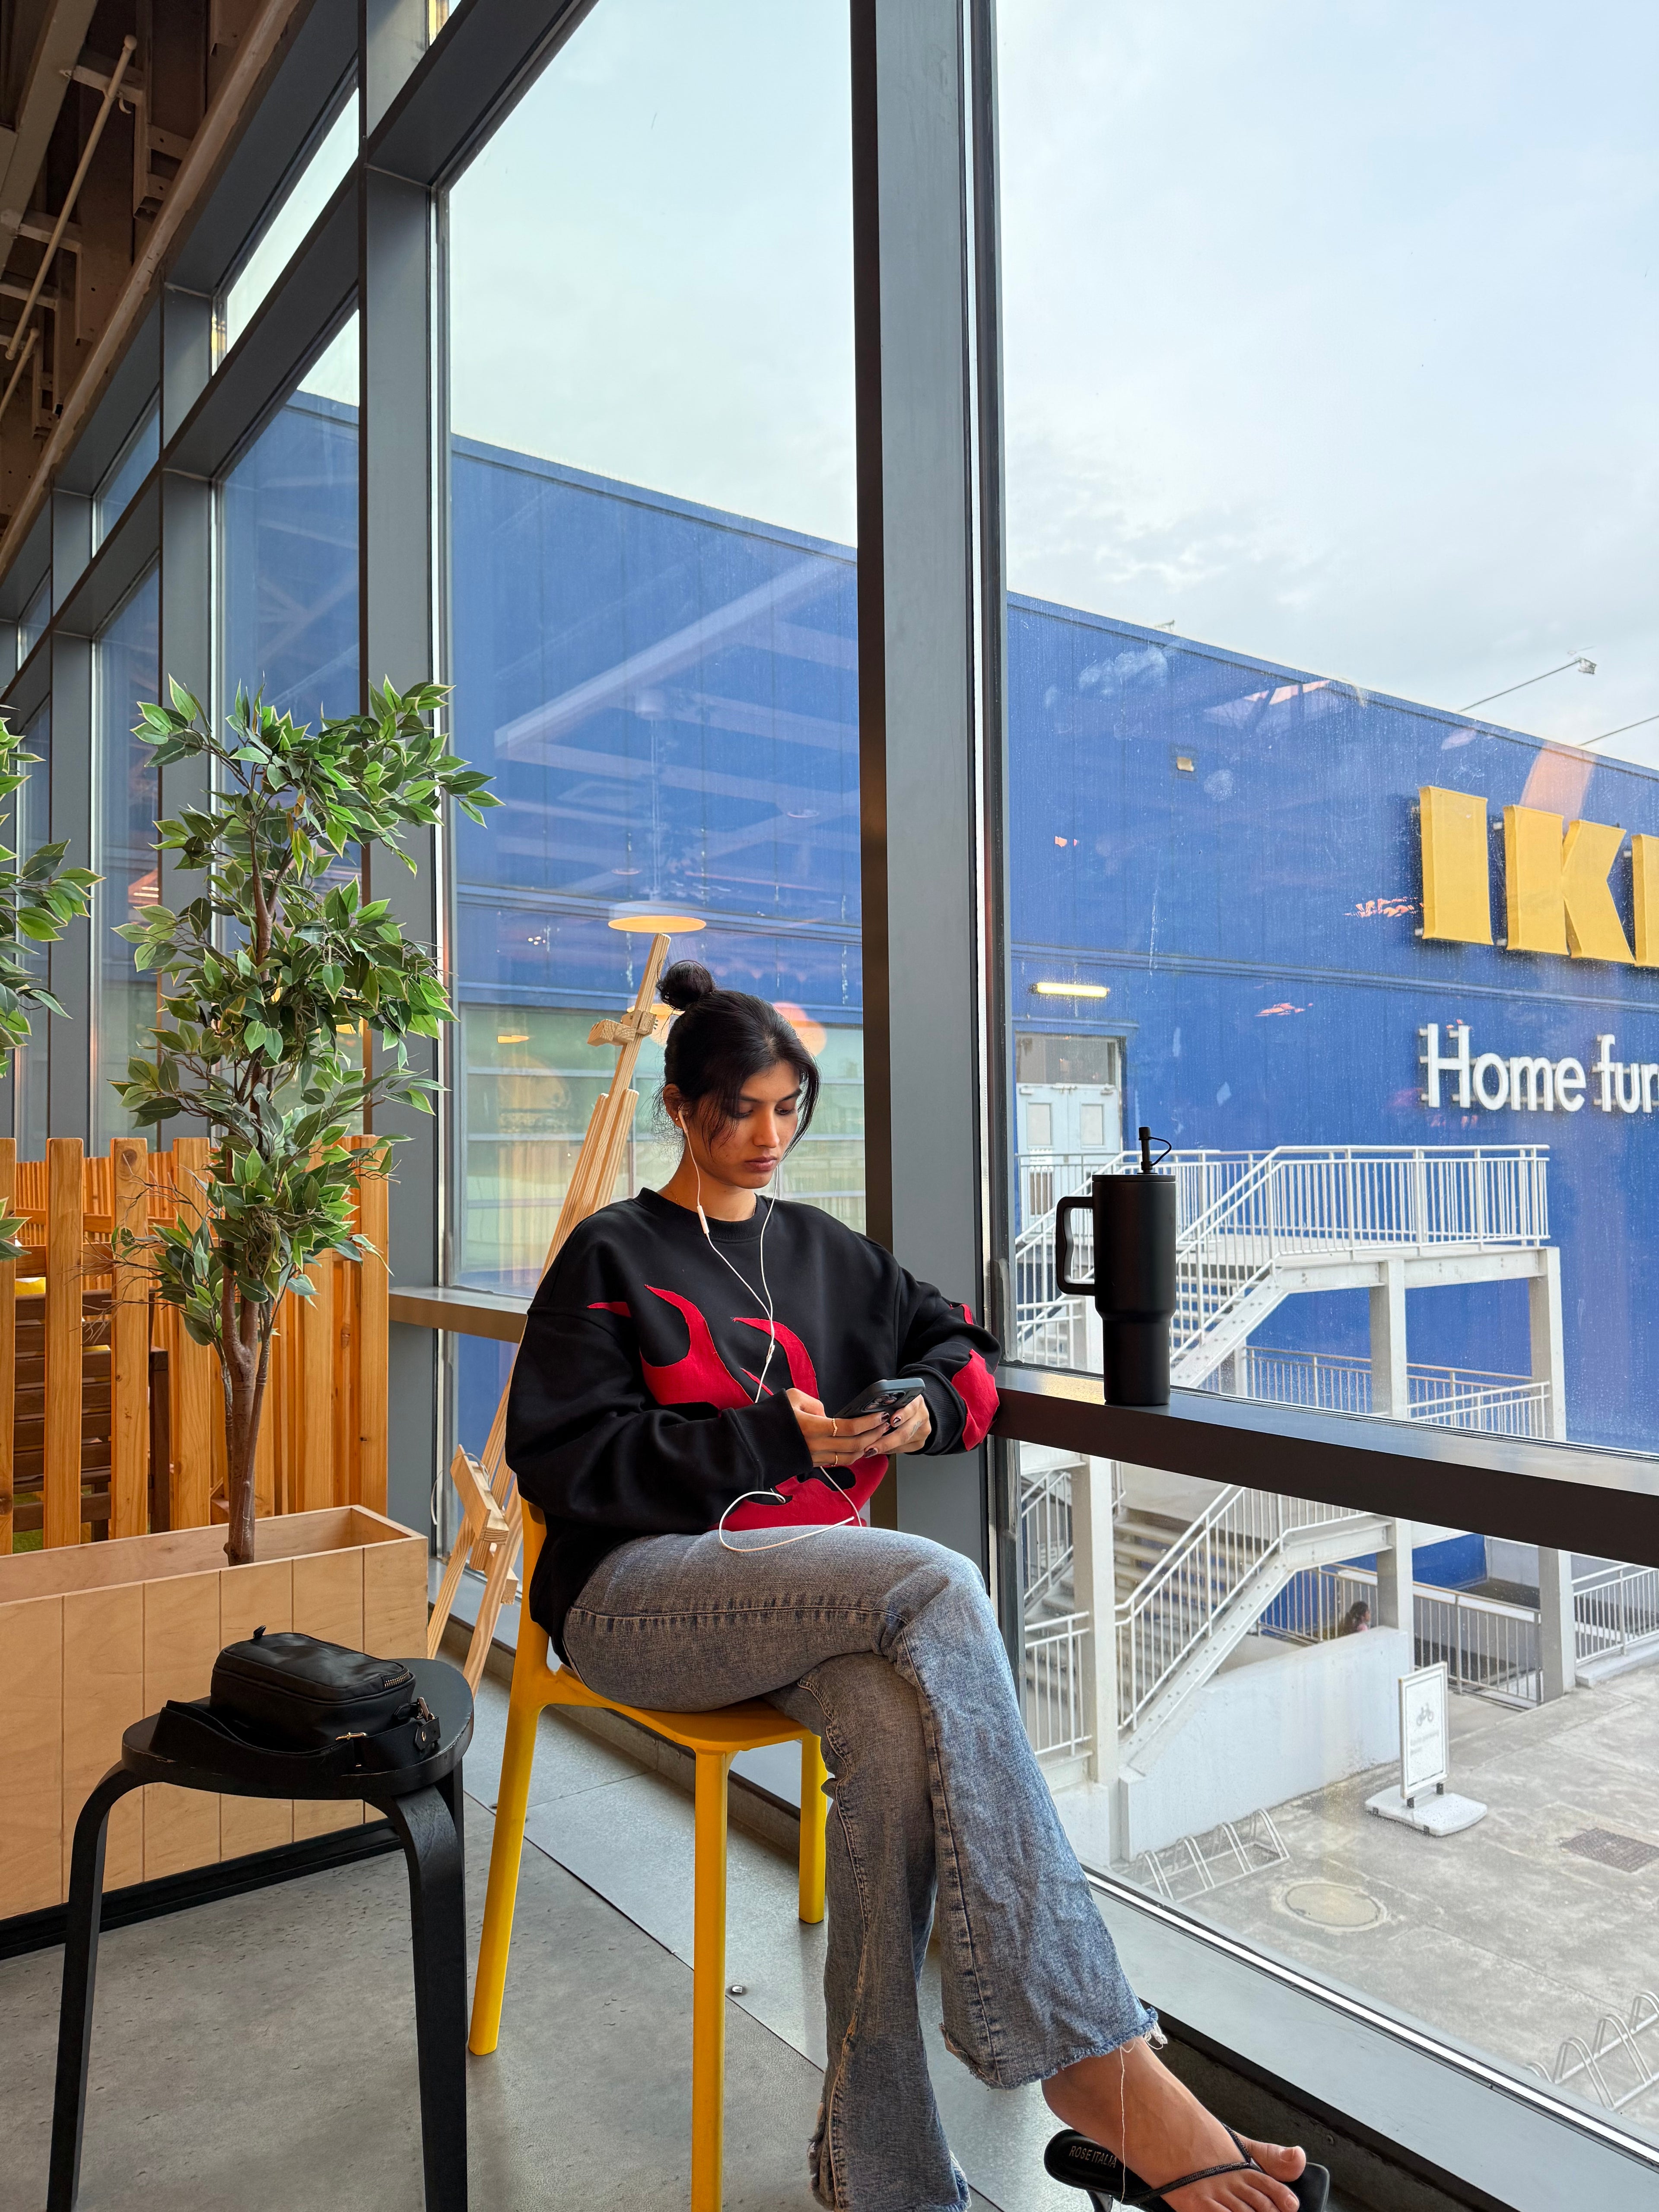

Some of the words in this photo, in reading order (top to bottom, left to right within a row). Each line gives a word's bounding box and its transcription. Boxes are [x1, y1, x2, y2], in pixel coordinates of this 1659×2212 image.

[1427, 1023, 1586, 1112] Home
[1597, 1034, 1659, 1113] fur
[1069, 2146, 1092, 2160] ROSE
[1092, 2151, 1118, 2168] ITALIA
